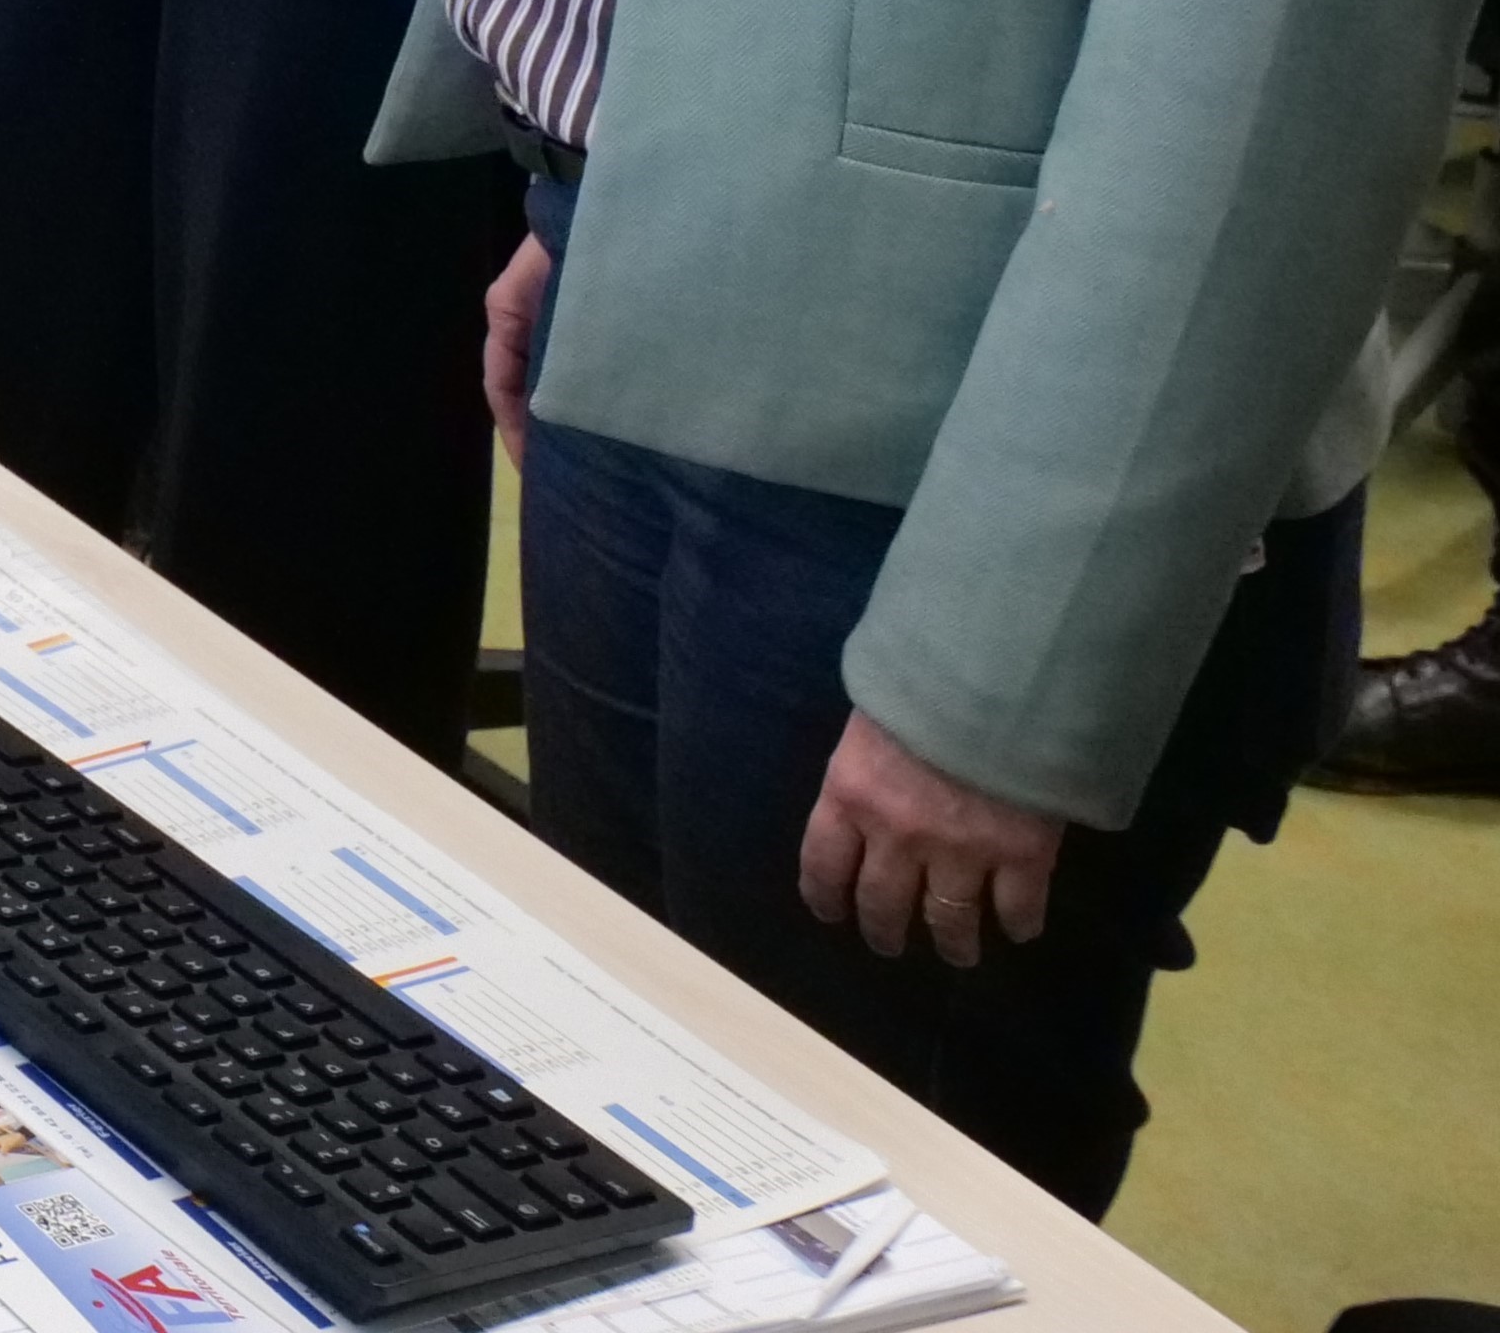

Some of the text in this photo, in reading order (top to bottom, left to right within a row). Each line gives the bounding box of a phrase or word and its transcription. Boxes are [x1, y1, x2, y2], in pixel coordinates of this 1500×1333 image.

[64, 1102, 111, 1139] Février
[227, 1241, 279, 1283] Janvier
[161, 1249, 245, 1321] Territoriale
